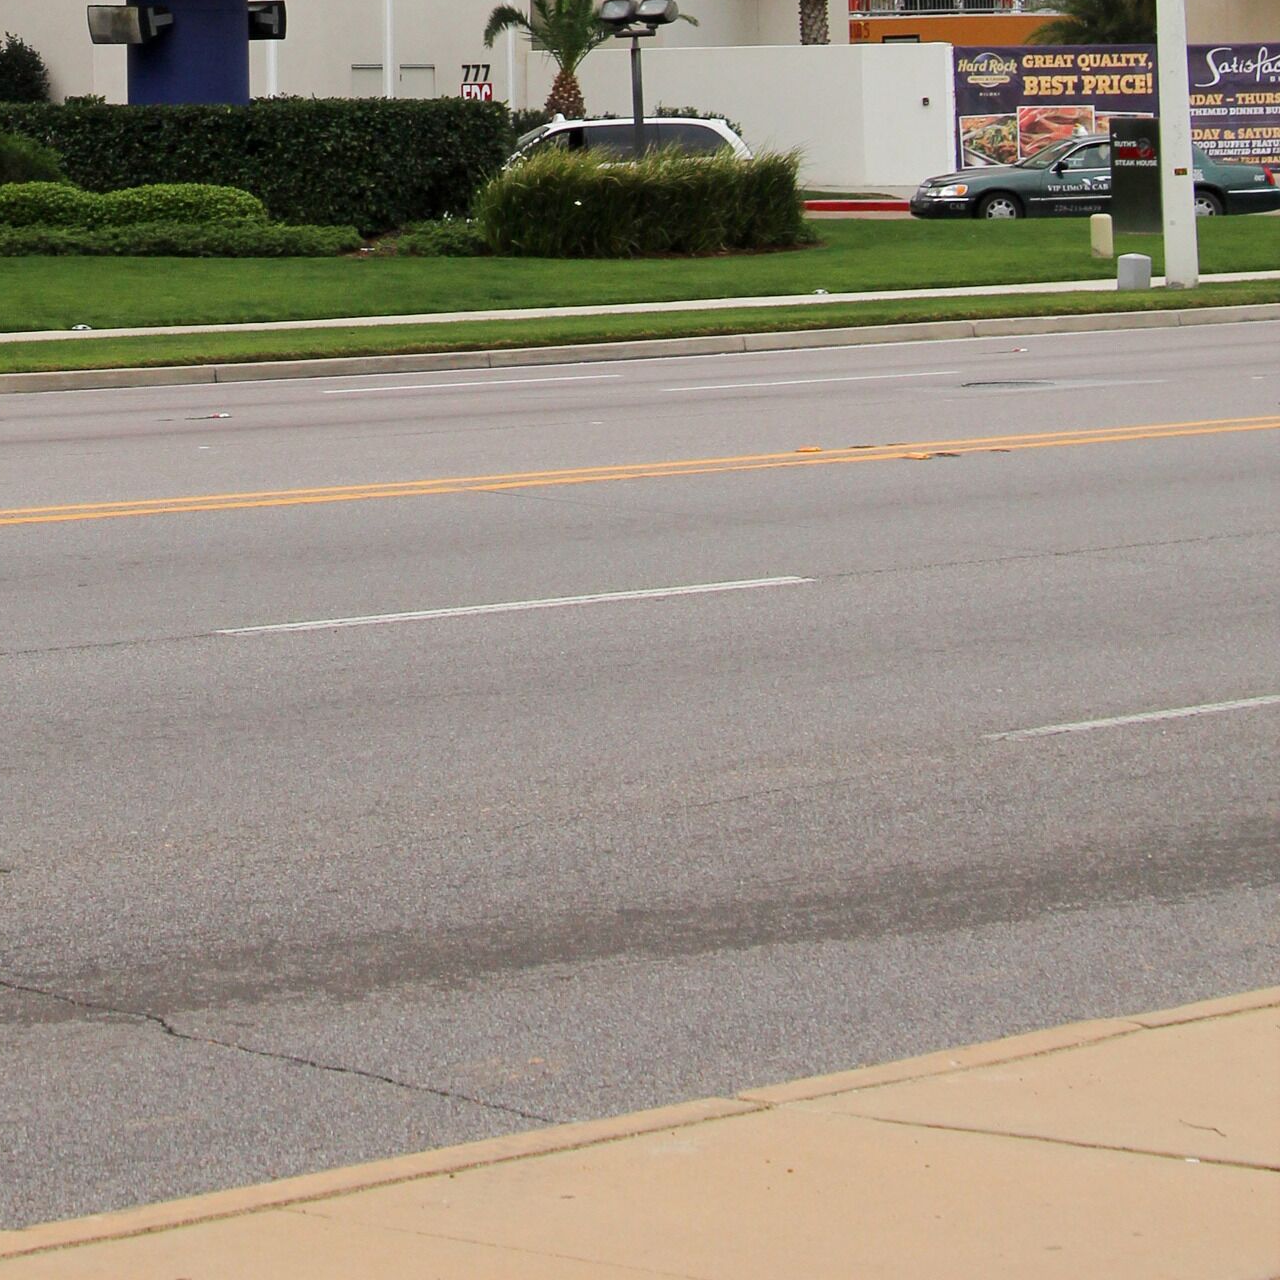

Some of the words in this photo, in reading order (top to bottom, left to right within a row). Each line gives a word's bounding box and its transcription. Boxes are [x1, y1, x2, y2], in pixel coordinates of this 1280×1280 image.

[958, 57, 989, 75] Hard
[989, 58, 1018, 75] Rock
[1022, 54, 1074, 69] GREAT
[1078, 53, 1153, 71] QUALITY,
[462, 64, 490, 82] 777
[1023, 75, 1078, 96] BEST
[1081, 73, 1153, 95] PRICE!
[1229, 107, 1264, 116] DINNER
[1192, 129, 1221, 140] DAY
[1252, 139, 1280, 147] FEATU
[1136, 159, 1158, 167] HOUSE
[1063, 184, 1083, 192] LIMO
